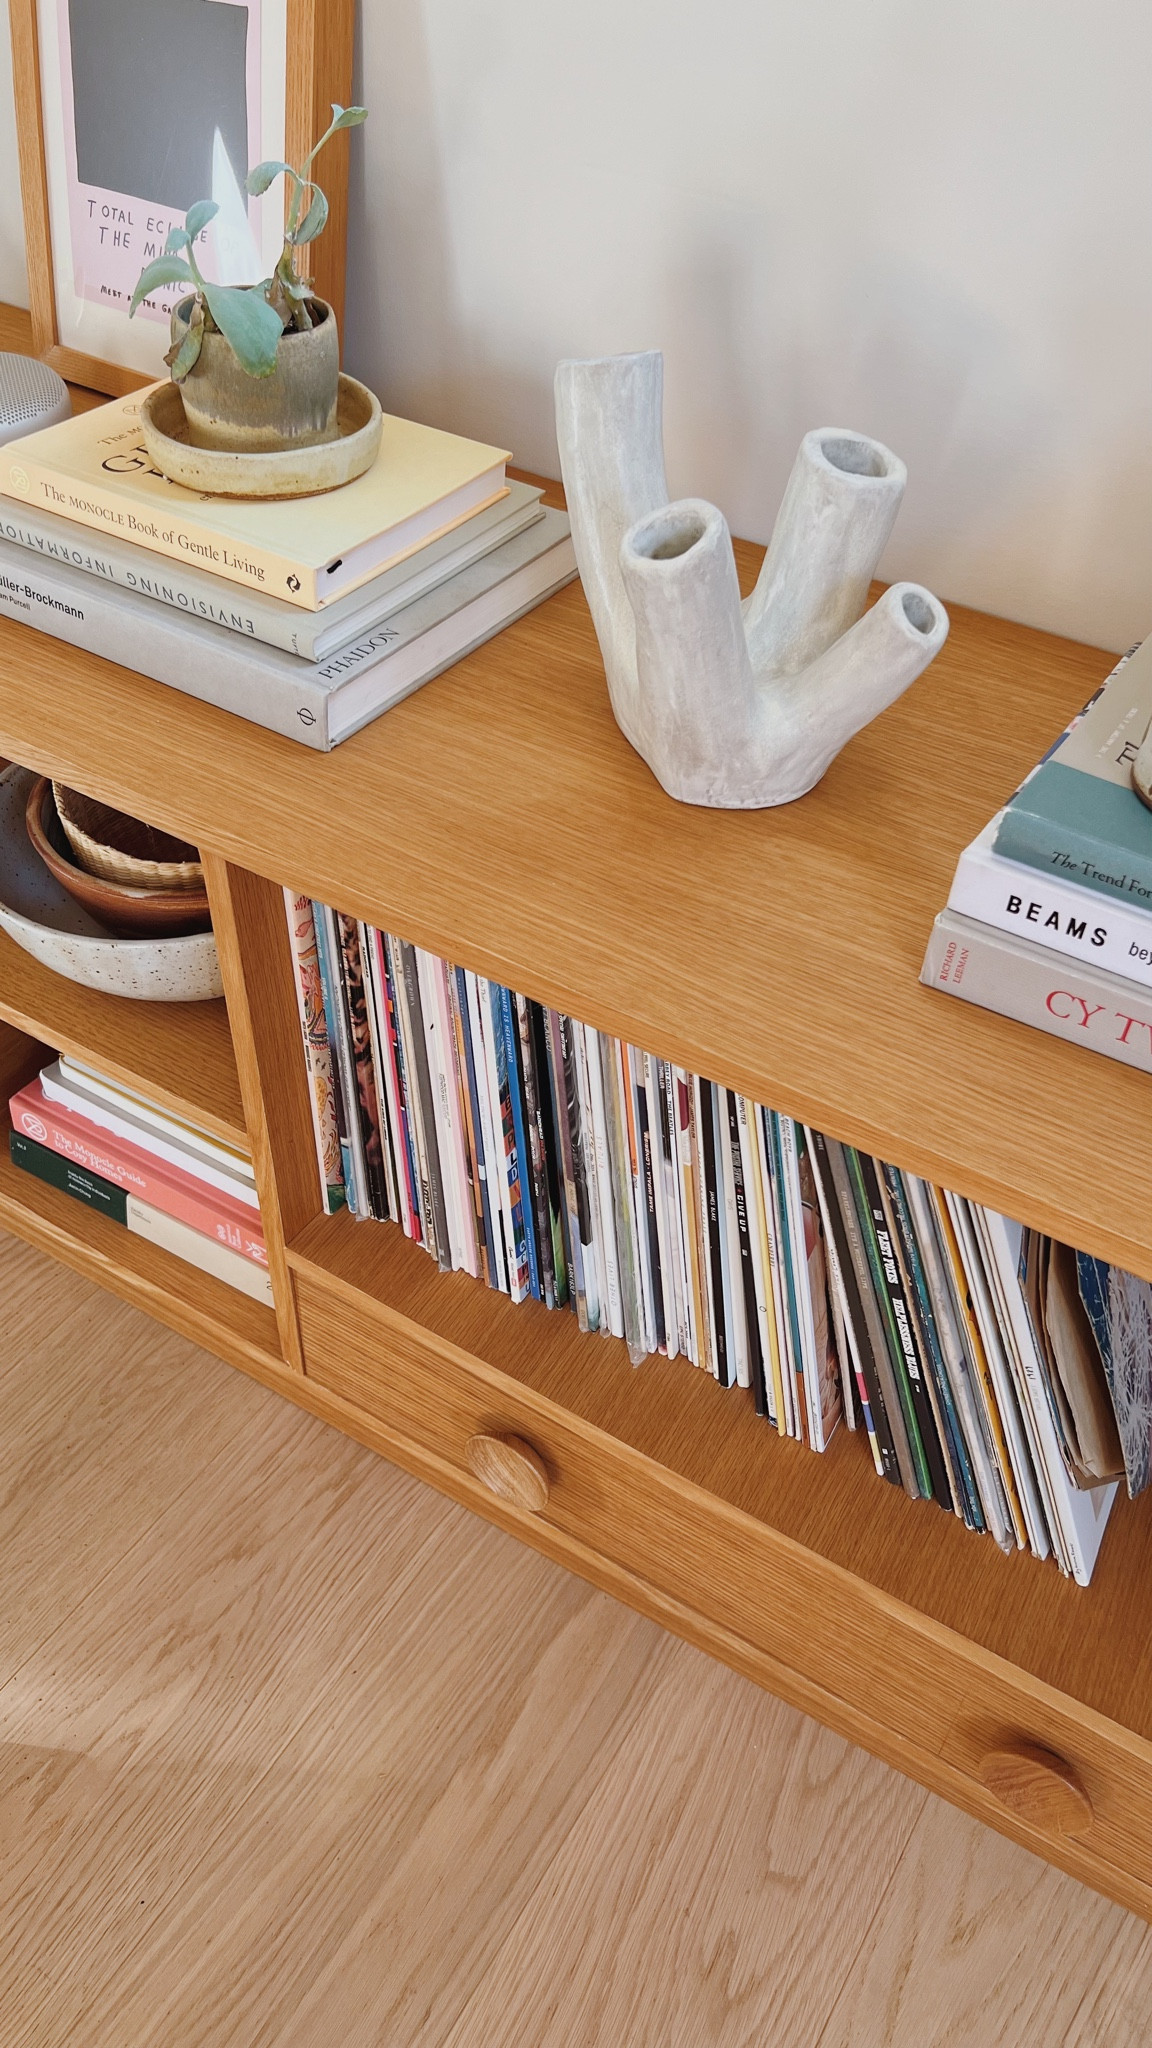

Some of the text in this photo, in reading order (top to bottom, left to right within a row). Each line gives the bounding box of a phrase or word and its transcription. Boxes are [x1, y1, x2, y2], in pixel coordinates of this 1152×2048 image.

[88, 199, 134, 226] TOTAL
[99, 226, 131, 249] THE
[100, 285, 122, 299] MEET
[142, 299, 156, 310] THE
[40, 482, 266, 582] The MONOCLE Book of Gentle Living
[126, 572, 255, 635] ENVISIONING
[317, 627, 400, 680] PHAIDON
[1050, 850, 1078, 872] The
[1081, 861, 1127, 890] Trend
[1005, 894, 1108, 947] BEAMS
[939, 941, 957, 982] RICHARD
[952, 947, 970, 985] LEEMAN
[504, 1015, 510, 1025] IS
[1045, 989, 1152, 1055] CY T
[504, 1025, 514, 1063] HEAVENWARD
[52, 1129, 72, 1150] The
[74, 1142, 115, 1170] Monocle
[116, 1166, 147, 1188] Guide
[597, 1135, 605, 1169] RITUALS
[643, 1131, 652, 1166] LONERISM
[89, 1157, 123, 1182] Homes
[736, 1195, 745, 1220] GIVE
[738, 1219, 747, 1233] UP
[876, 1229, 890, 1259] FLEET
[607, 1260, 618, 1306] OTHER LIVES
[860, 1275, 868, 1290] LIFE
[881, 1256, 898, 1285] FOXES
[904, 1354, 920, 1381] BLUES
